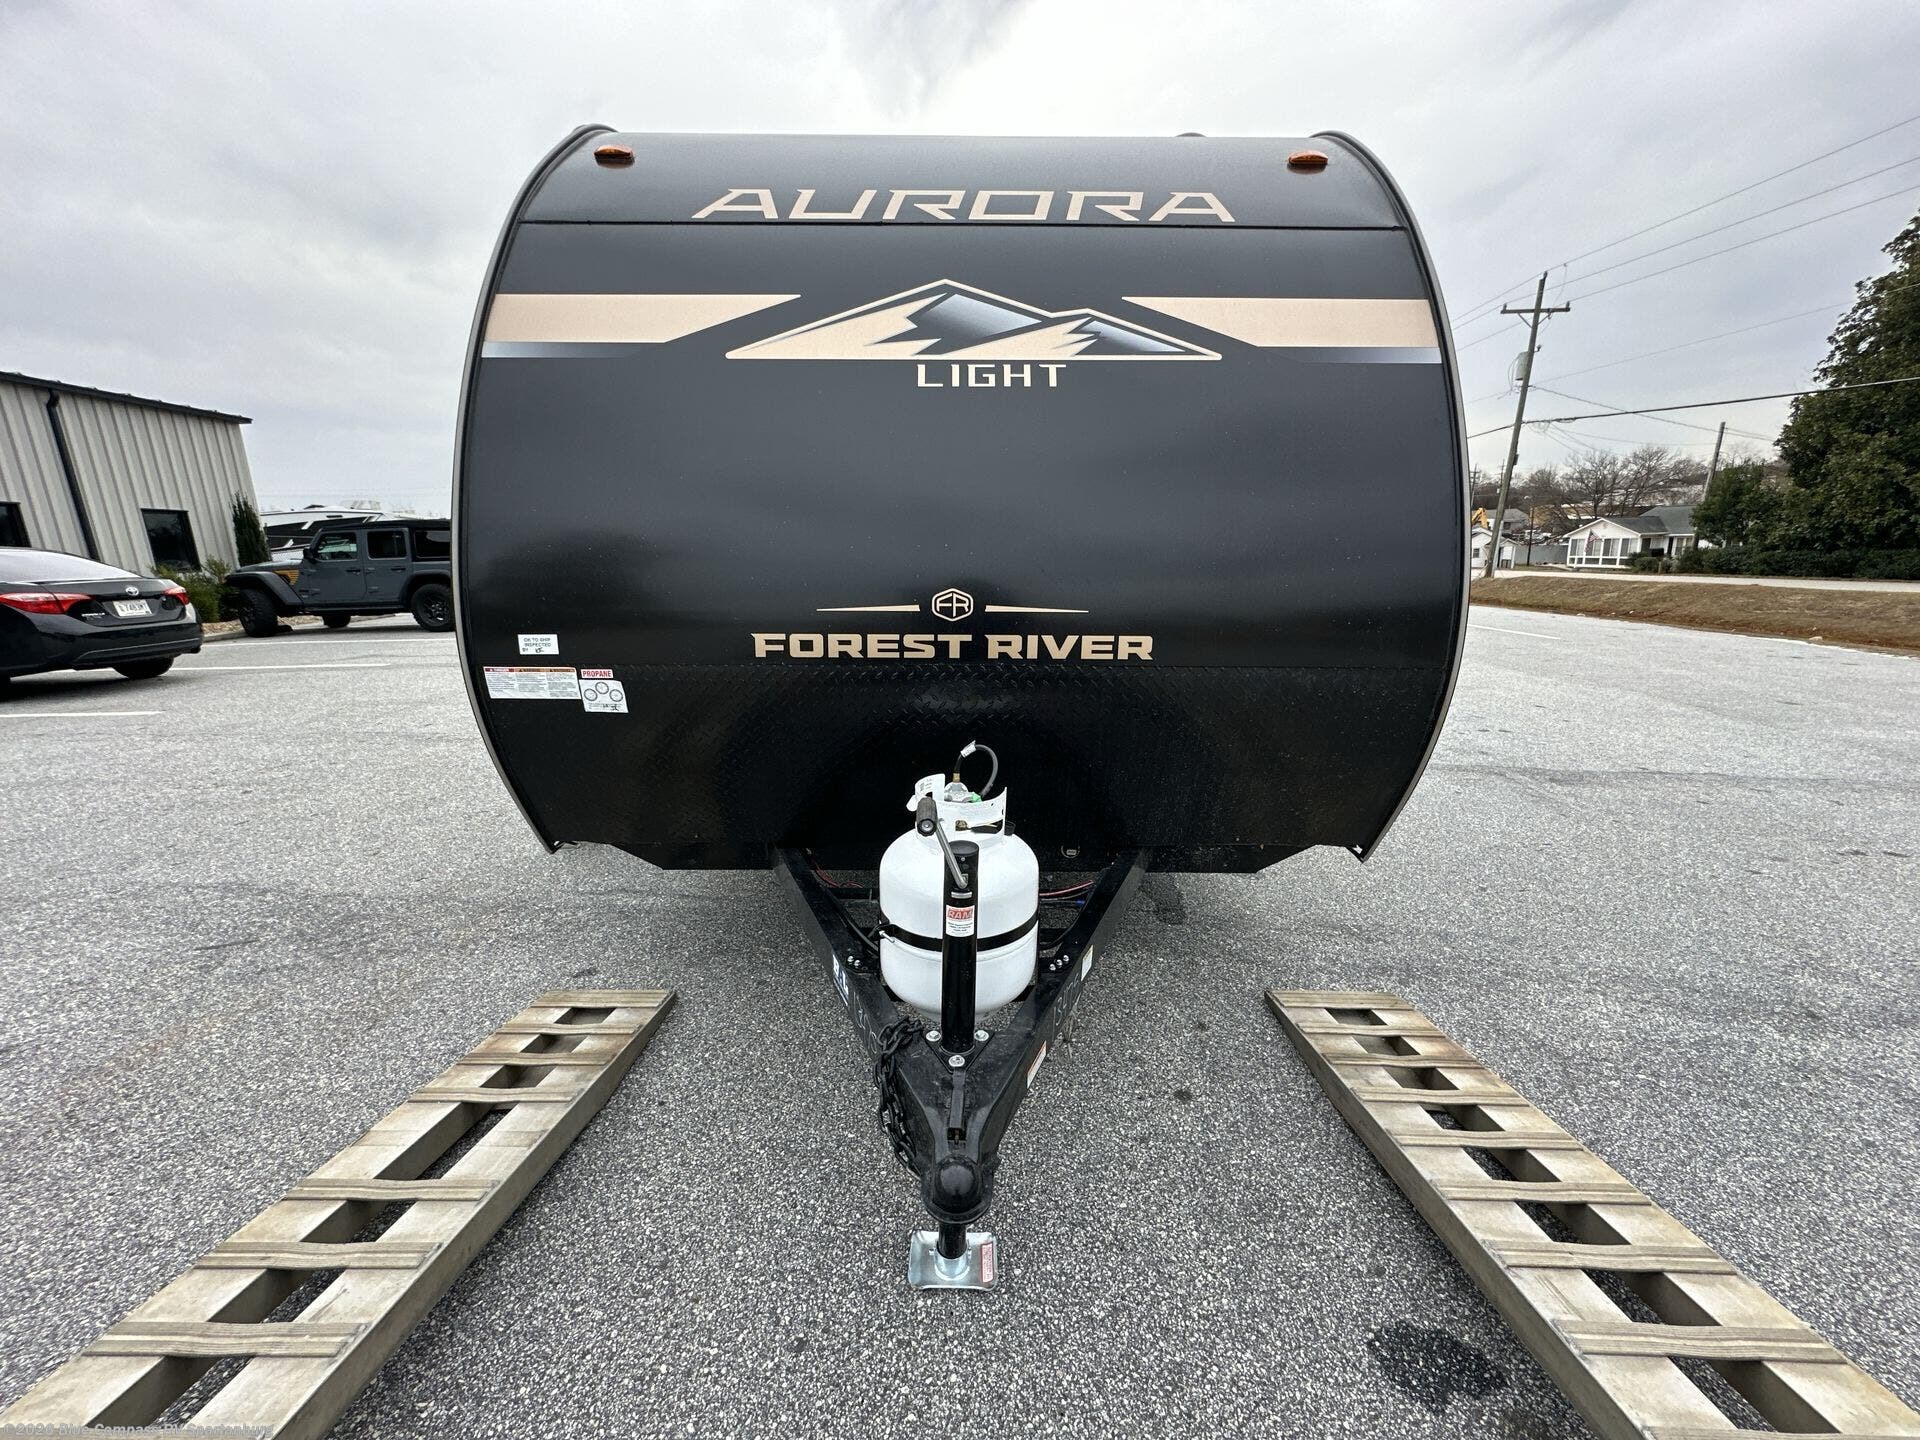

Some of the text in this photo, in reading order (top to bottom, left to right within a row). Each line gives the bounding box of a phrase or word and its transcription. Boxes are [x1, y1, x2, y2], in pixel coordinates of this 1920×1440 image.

[691, 188, 1236, 222] AURORA
[916, 363, 1067, 388] LIGHT
[750, 632, 1154, 661] FOREST RIVER
[582, 670, 612, 678] PROPANE
